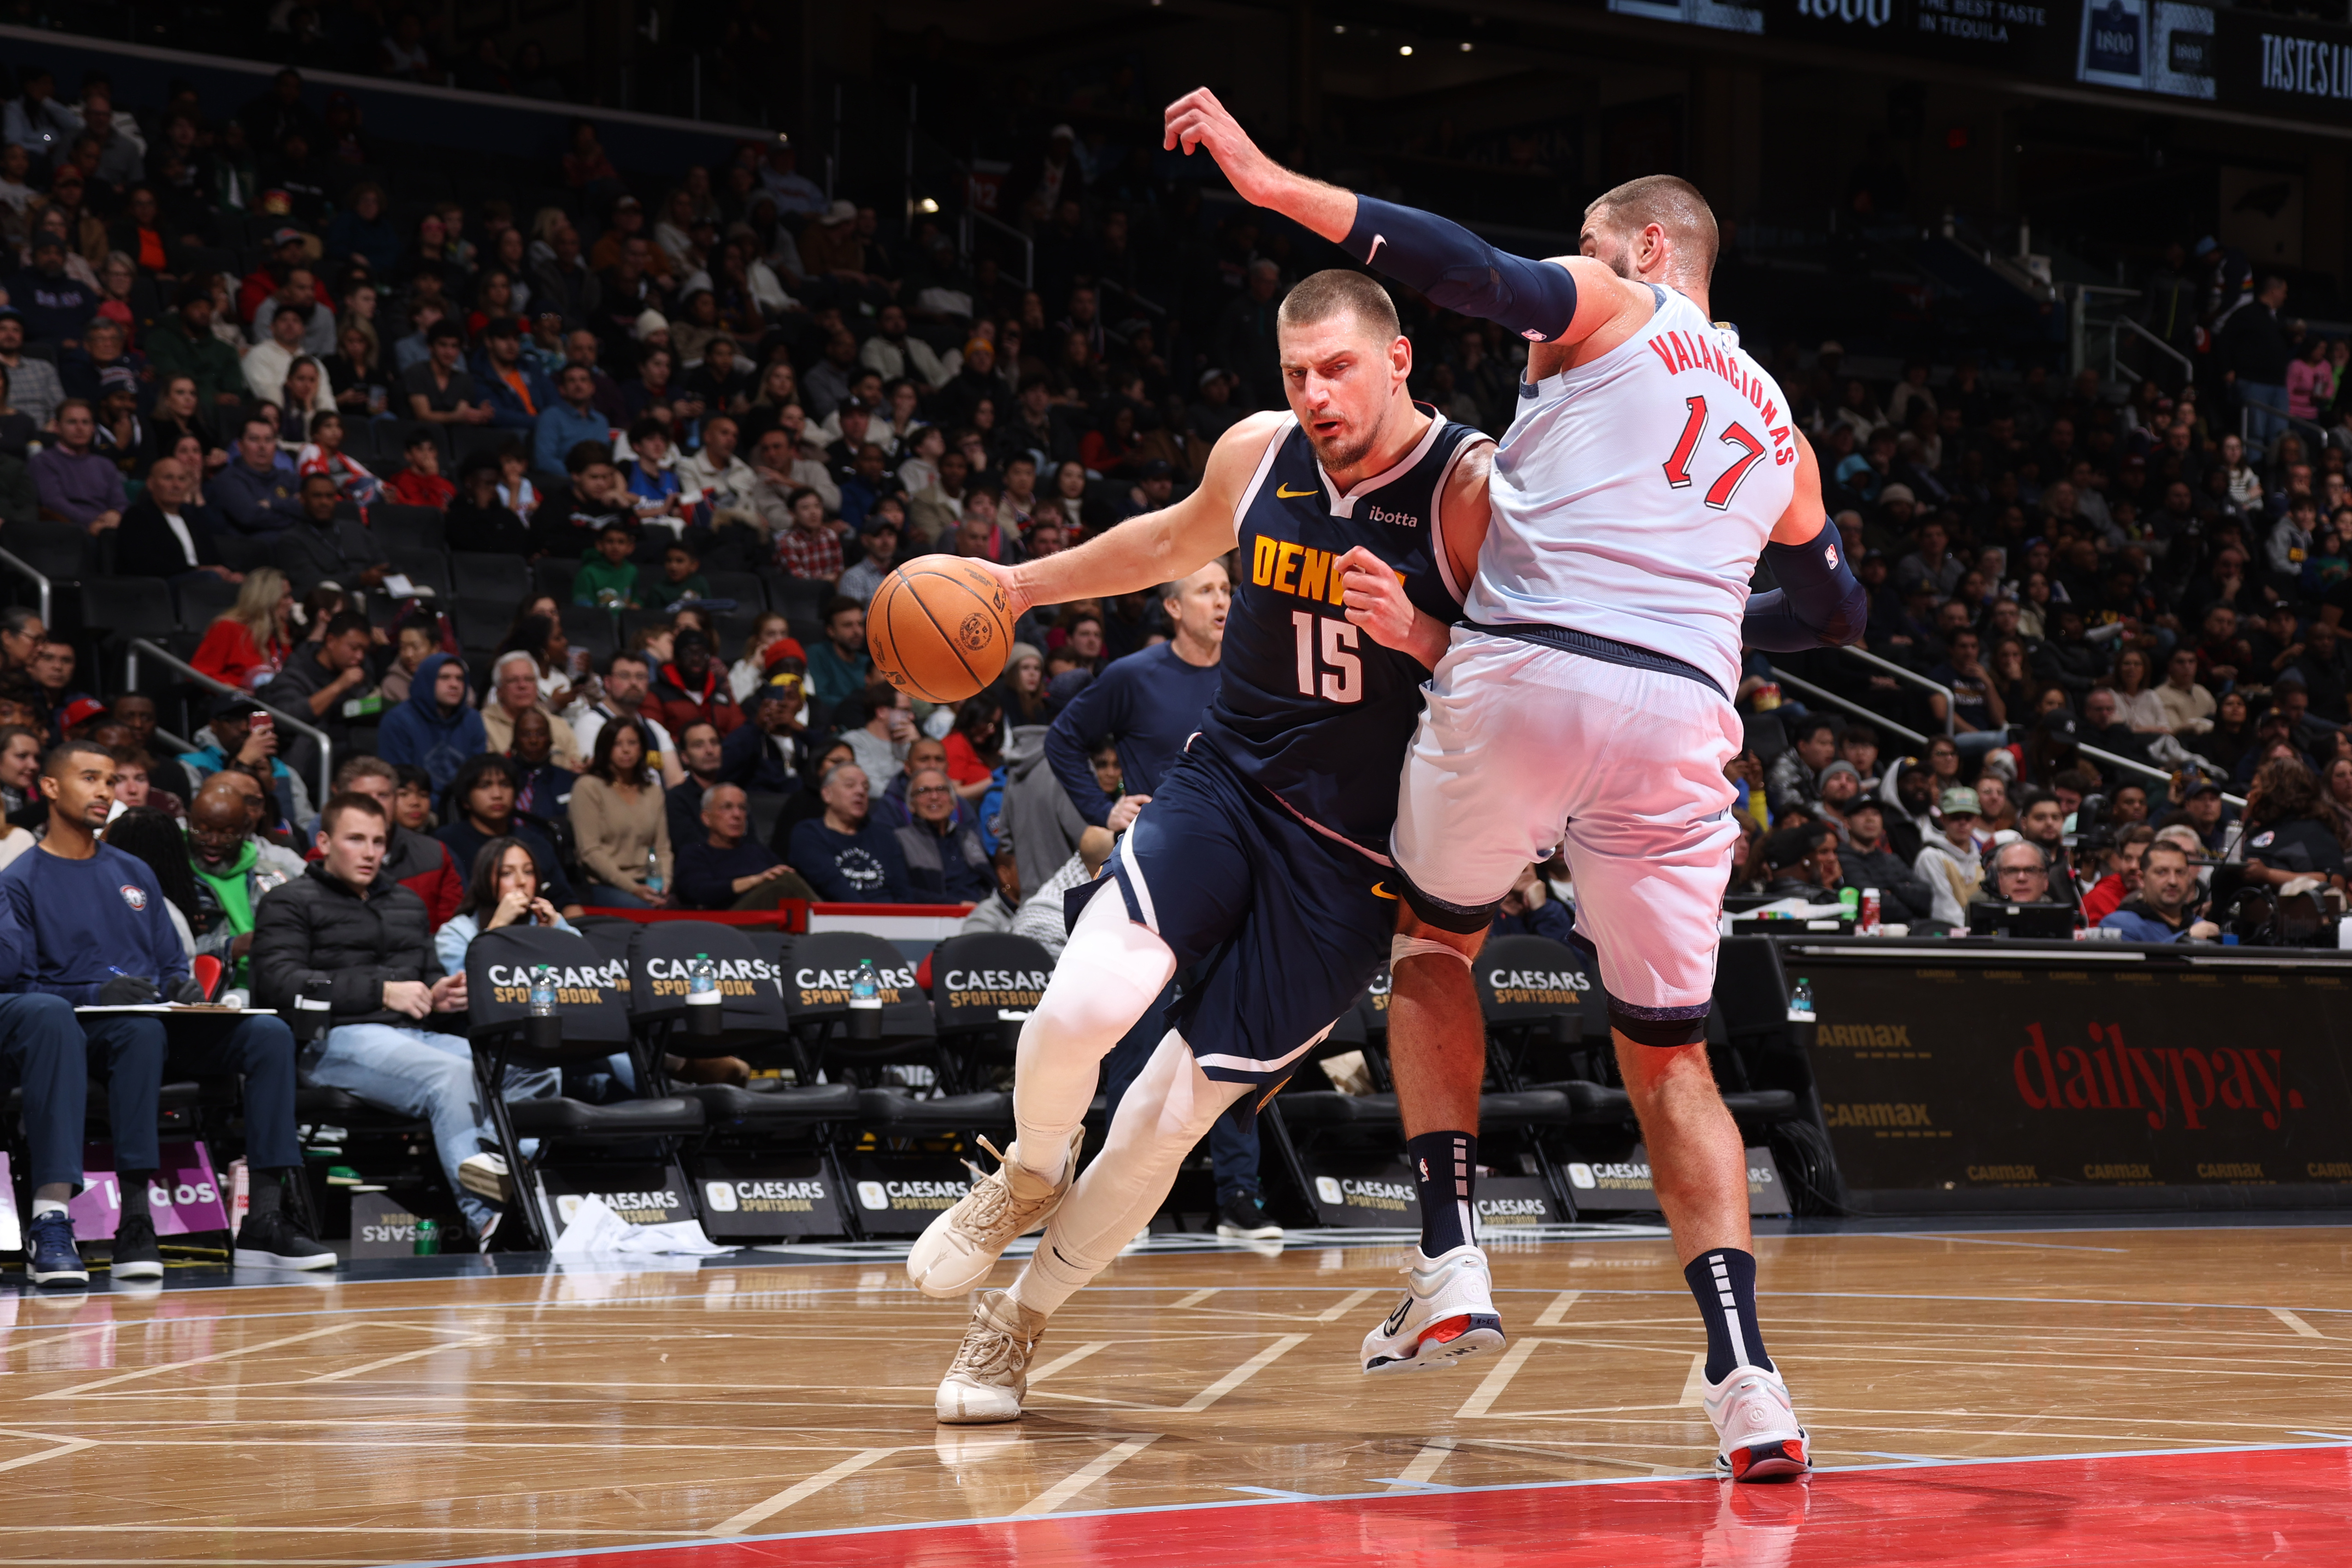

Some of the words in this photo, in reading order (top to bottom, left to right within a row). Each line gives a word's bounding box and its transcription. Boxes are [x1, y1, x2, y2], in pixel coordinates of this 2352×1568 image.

[1997, 2, 2047, 27] TASTE
[1918, 12, 1936, 33] IN
[1940, 16, 2010, 44] TEQUILA
[2262, 32, 2328, 96] TASTES
[1662, 395, 1767, 511] 17
[1369, 505, 1418, 528] ibotta
[1291, 610, 1364, 705] 15
[1489, 969, 1590, 991] CAESARS
[494, 987, 603, 1004] SPOBOOK
[949, 991, 1043, 1008] SPORTSBOO
[1494, 989, 1580, 1004] SPORTSBOOK
[1592, 1163, 1652, 1179] CAESAR
[736, 1181, 825, 1199] CAESARS
[886, 1181, 970, 1198] CAESARS
[1341, 1179, 1416, 1202] CAESARS
[1597, 1178, 1653, 1190] SPORTSBOO
[104, 1178, 216, 1210] ldos
[596, 1191, 679, 1210] AESARS
[1346, 1194, 1408, 1212] SPORTSBOOK
[740, 1198, 814, 1212] SPORTSBOOK
[1478, 1199, 1546, 1216] CAESARS
[1483, 1215, 1538, 1225] SPORTSBOOK
